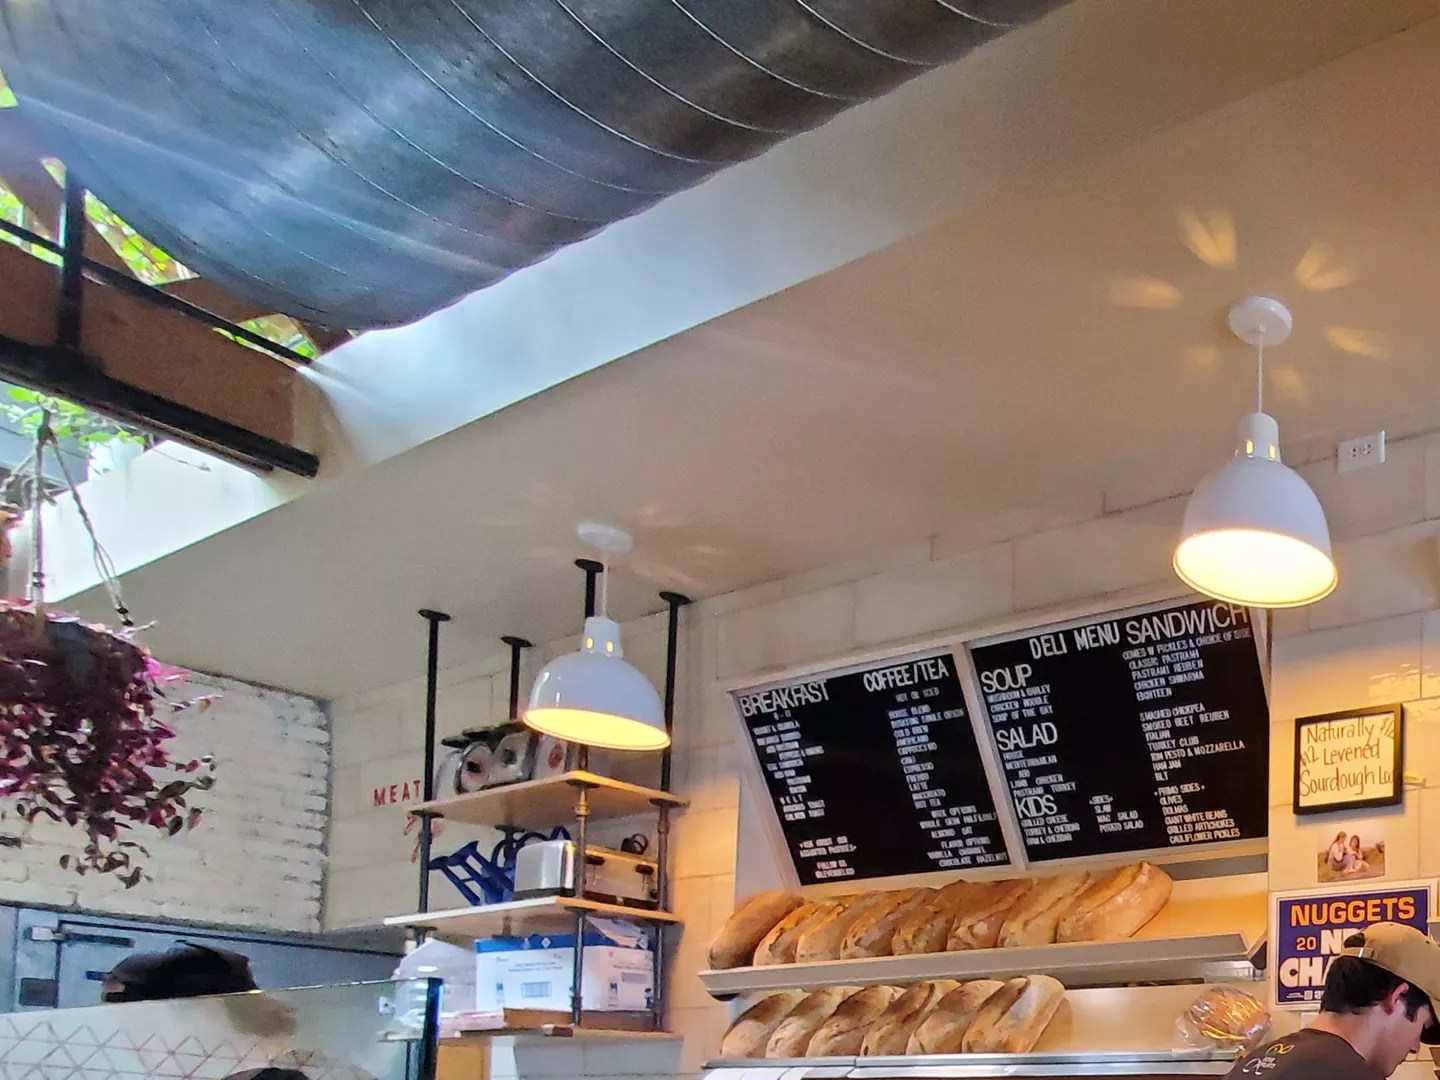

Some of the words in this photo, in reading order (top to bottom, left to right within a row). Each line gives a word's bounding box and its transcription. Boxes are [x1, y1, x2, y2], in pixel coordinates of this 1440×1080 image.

[1030, 633, 1067, 659] DELI
[1073, 622, 1120, 651] MENU
[1126, 603, 1248, 645] SANDWICH
[864, 659, 949, 692] COFFEE/TEA
[981, 664, 1032, 693] SOUP
[740, 680, 829, 717] BREAKFAST
[996, 722, 1058, 751] SALAD
[1307, 717, 1374, 744] Naturally
[1324, 738, 1380, 765] Levened
[374, 780, 420, 807] MEAT
[1300, 765, 1375, 797] Sourdough
[1014, 794, 1058, 819] KIDS
[1291, 896, 1415, 927] NUGGETS
[1296, 937, 1316, 950] 20
